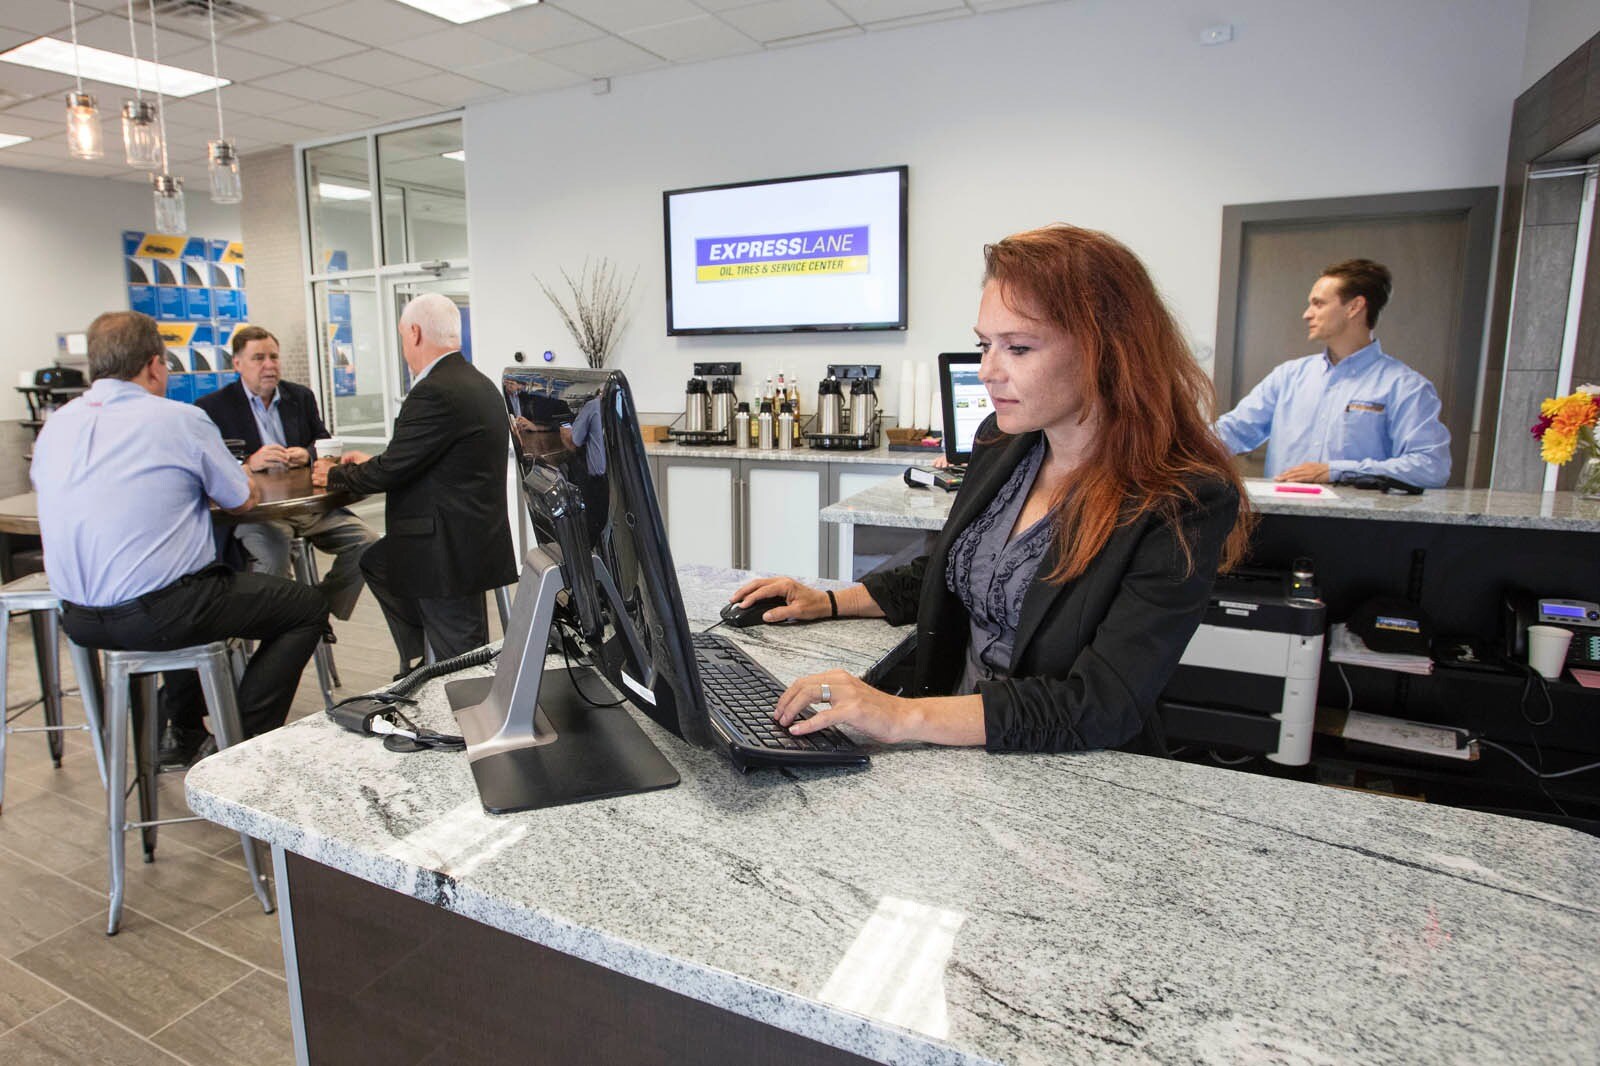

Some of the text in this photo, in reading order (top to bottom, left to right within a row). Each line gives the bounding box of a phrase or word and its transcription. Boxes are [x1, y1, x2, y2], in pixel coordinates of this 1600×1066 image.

[737, 265, 760, 275] TIRES
[761, 264, 768, 274] &
[770, 262, 805, 273] SERVICE
[808, 260, 844, 270] CENTER
